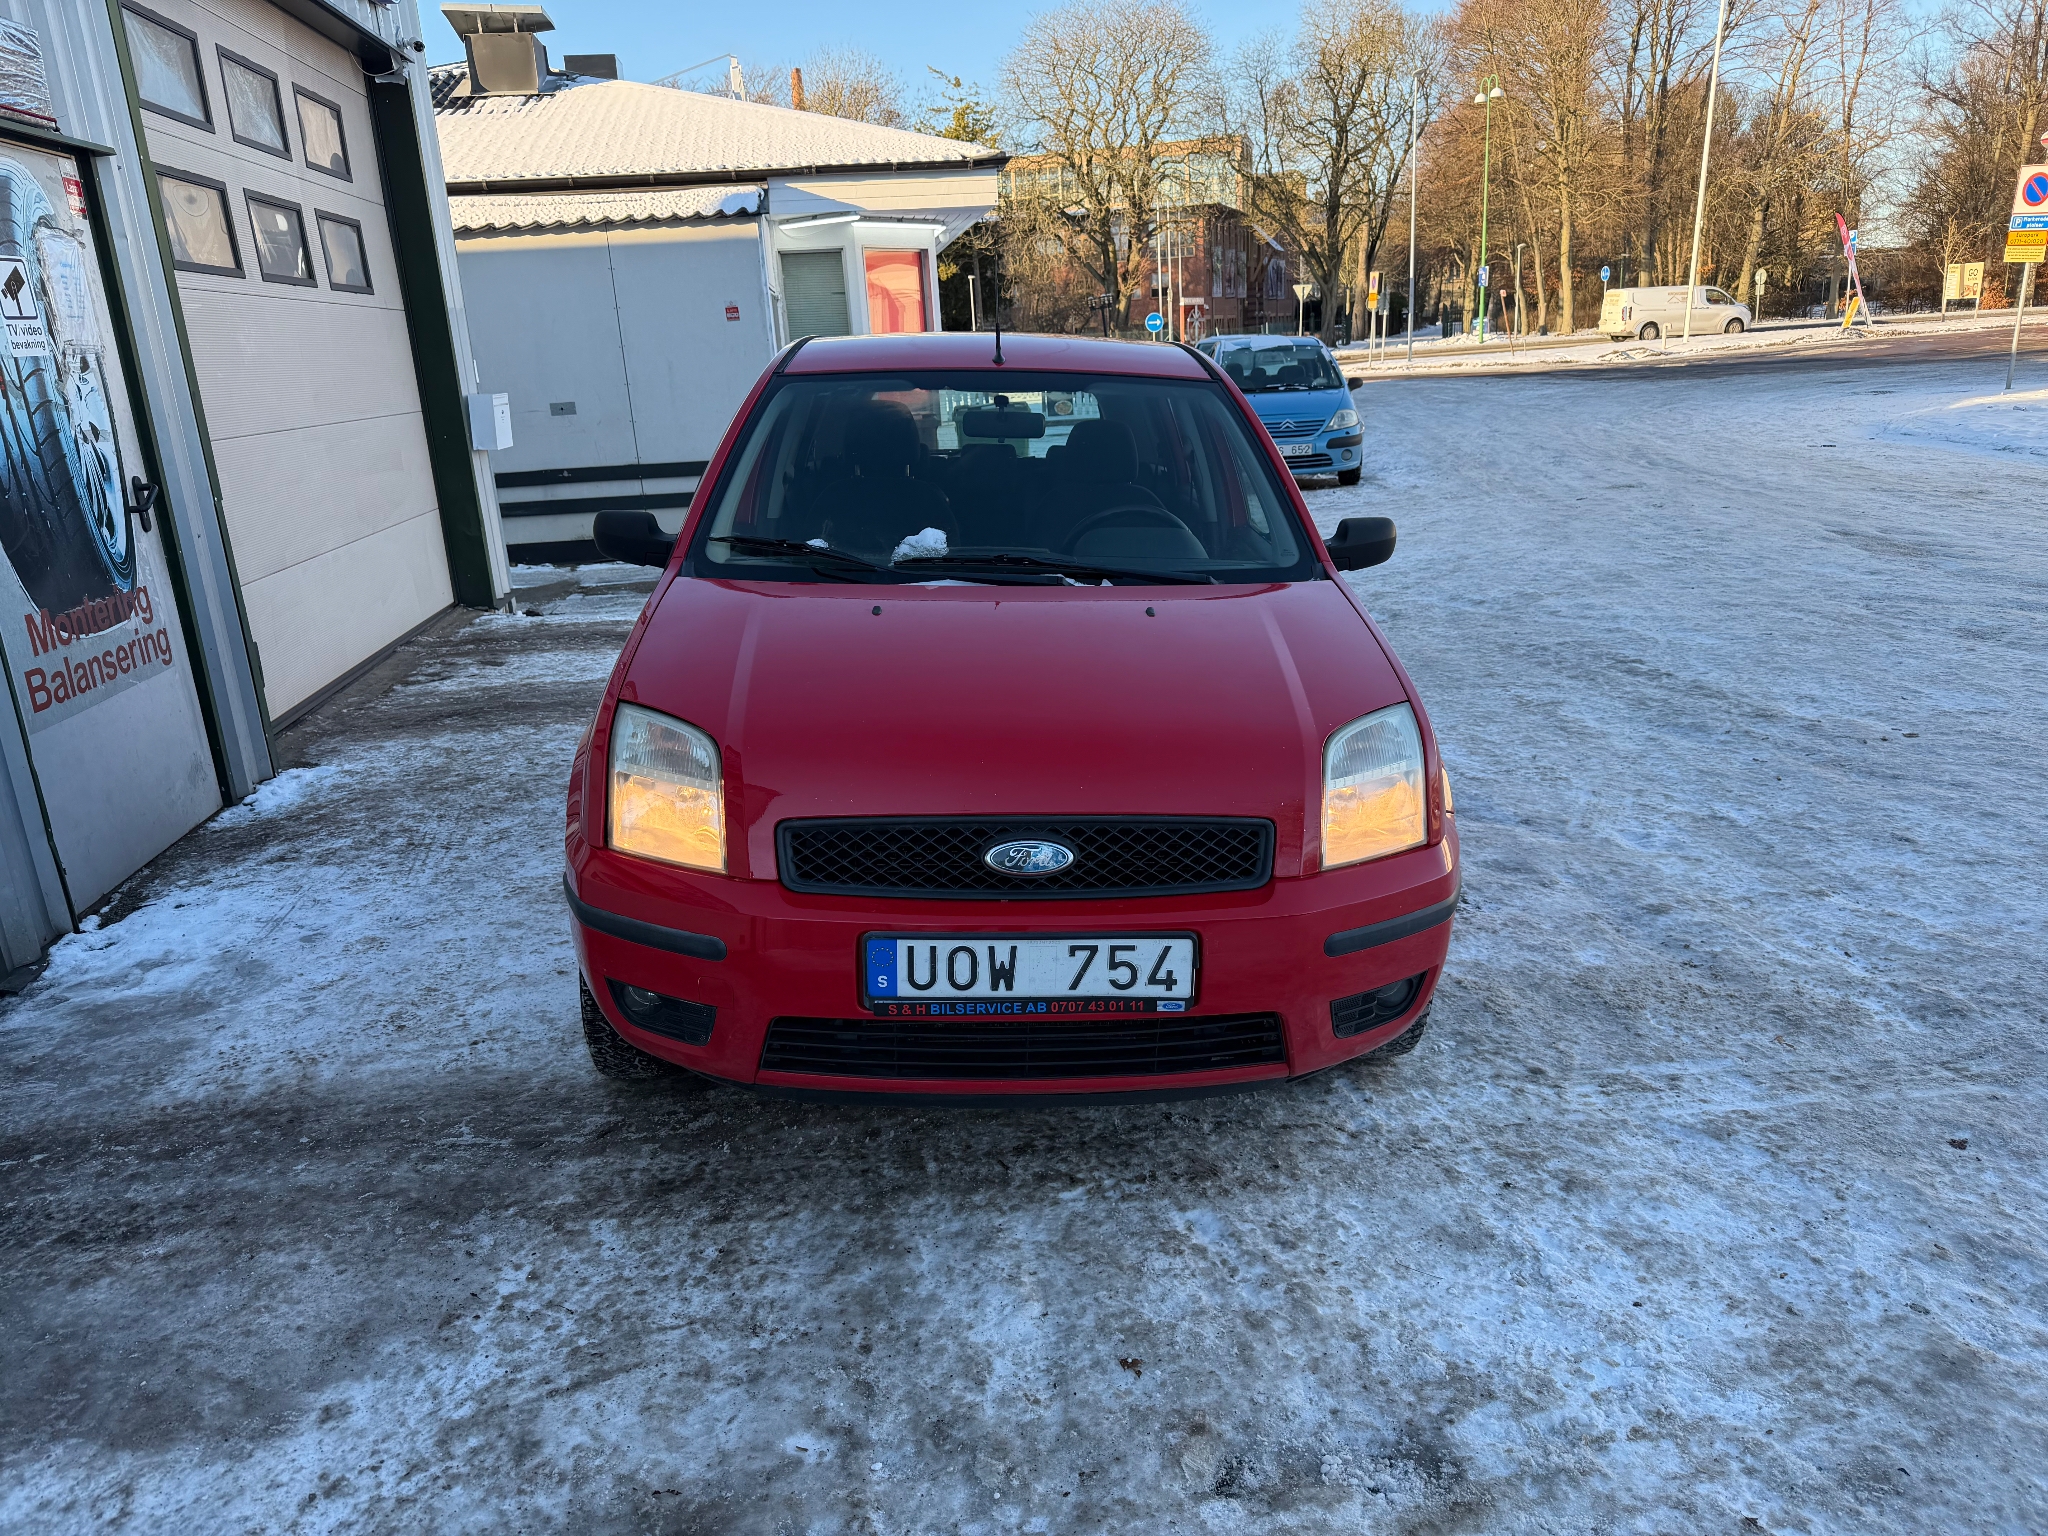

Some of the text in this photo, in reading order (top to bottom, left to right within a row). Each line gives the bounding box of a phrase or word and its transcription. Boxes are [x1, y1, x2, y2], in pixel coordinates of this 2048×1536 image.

[5, 323, 43, 337] TV/video
[10, 338, 46, 351] bevakning
[1291, 444, 1311, 455] 652
[24, 585, 154, 657] Montering
[24, 627, 173, 714] Balansering
[1004, 846, 1056, 867] Ford
[907, 944, 1178, 991] UOW 754
[877, 975, 888, 988] S
[888, 1000, 1144, 1015] S & H BILSERVICE AB 0707 43 01 11
